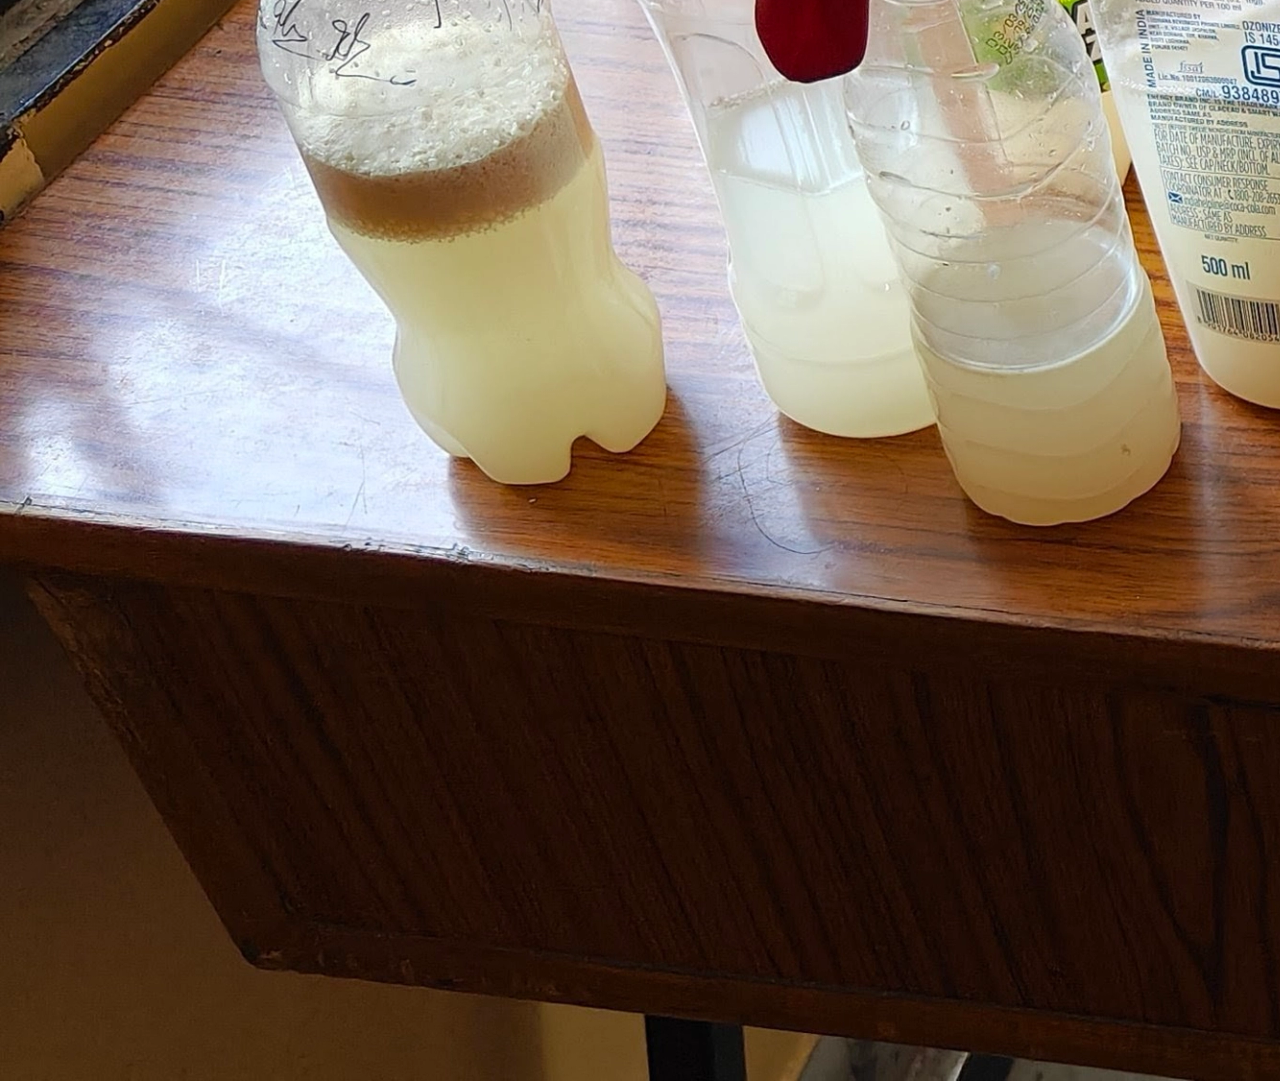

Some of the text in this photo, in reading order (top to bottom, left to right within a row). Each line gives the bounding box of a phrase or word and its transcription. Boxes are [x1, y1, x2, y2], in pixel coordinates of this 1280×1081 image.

[1135, 9, 1157, 88] MADE IN INDIA
[1244, 31, 1257, 43] IS
[1201, 254, 1251, 280] 500 ml
